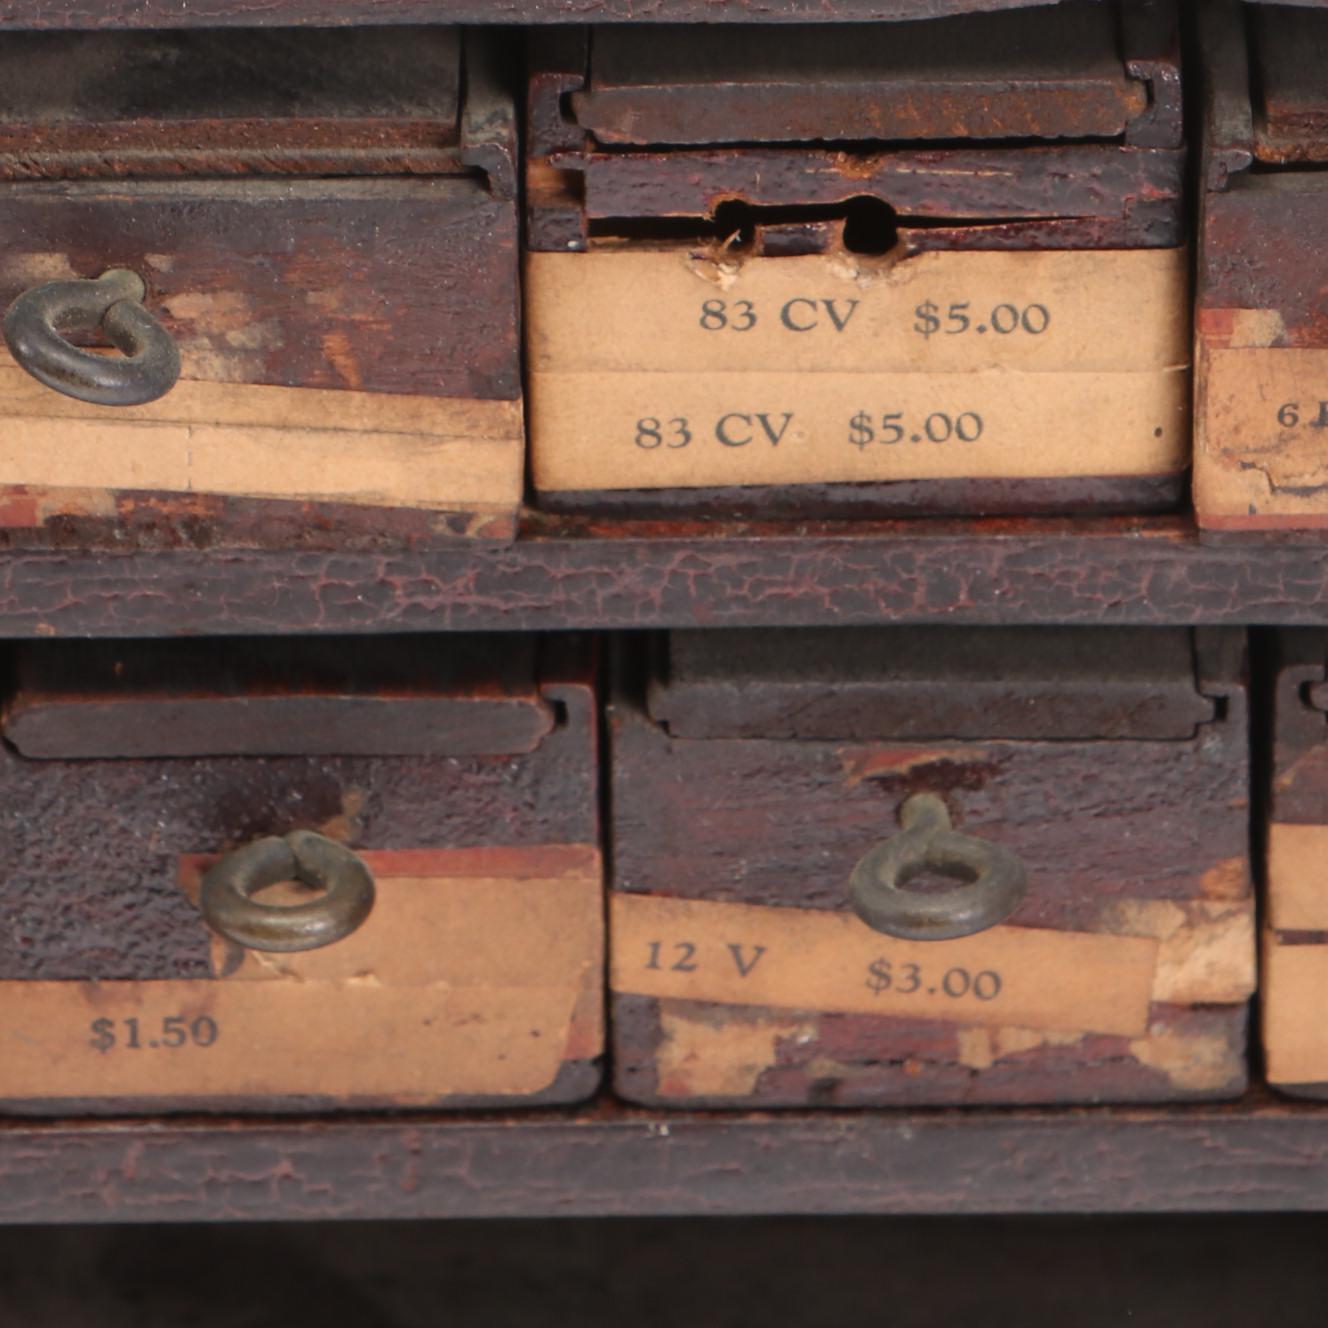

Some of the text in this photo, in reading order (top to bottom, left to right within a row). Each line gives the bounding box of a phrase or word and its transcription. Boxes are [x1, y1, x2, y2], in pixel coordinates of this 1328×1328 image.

[699, 297, 1051, 341] 83 CV $5.00
[634, 410, 984, 452] 83 CV $5.00
[1276, 402, 1300, 429] 6
[645, 940, 1003, 1002] 12 V $3.00
[88, 1011, 220, 1056] $1.50
